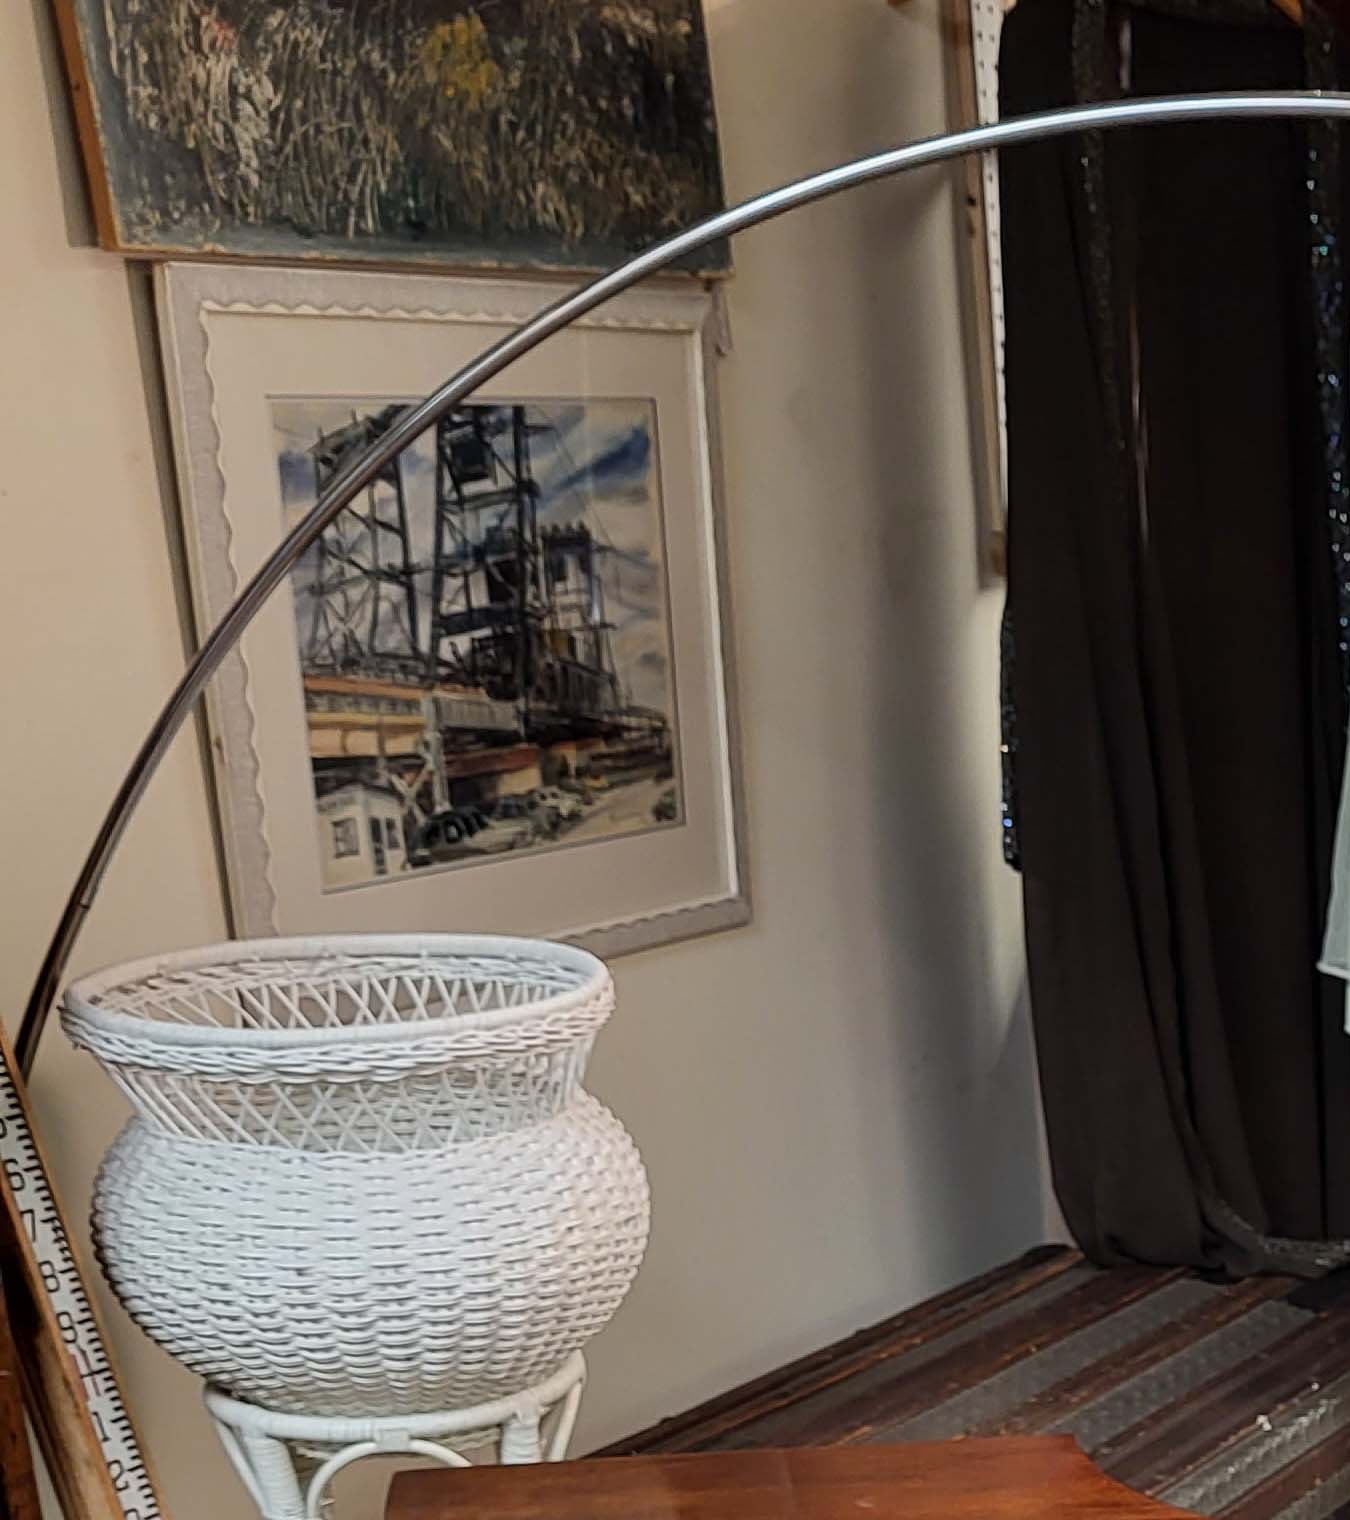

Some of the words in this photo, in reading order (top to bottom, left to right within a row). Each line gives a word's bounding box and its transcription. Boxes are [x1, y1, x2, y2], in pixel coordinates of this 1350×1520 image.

[3, 1159, 25, 1191] 6
[38, 1260, 60, 1292] 8
[57, 1312, 78, 1343] 9
[92, 1412, 110, 1442] 1
[107, 1462, 128, 1491] 2
